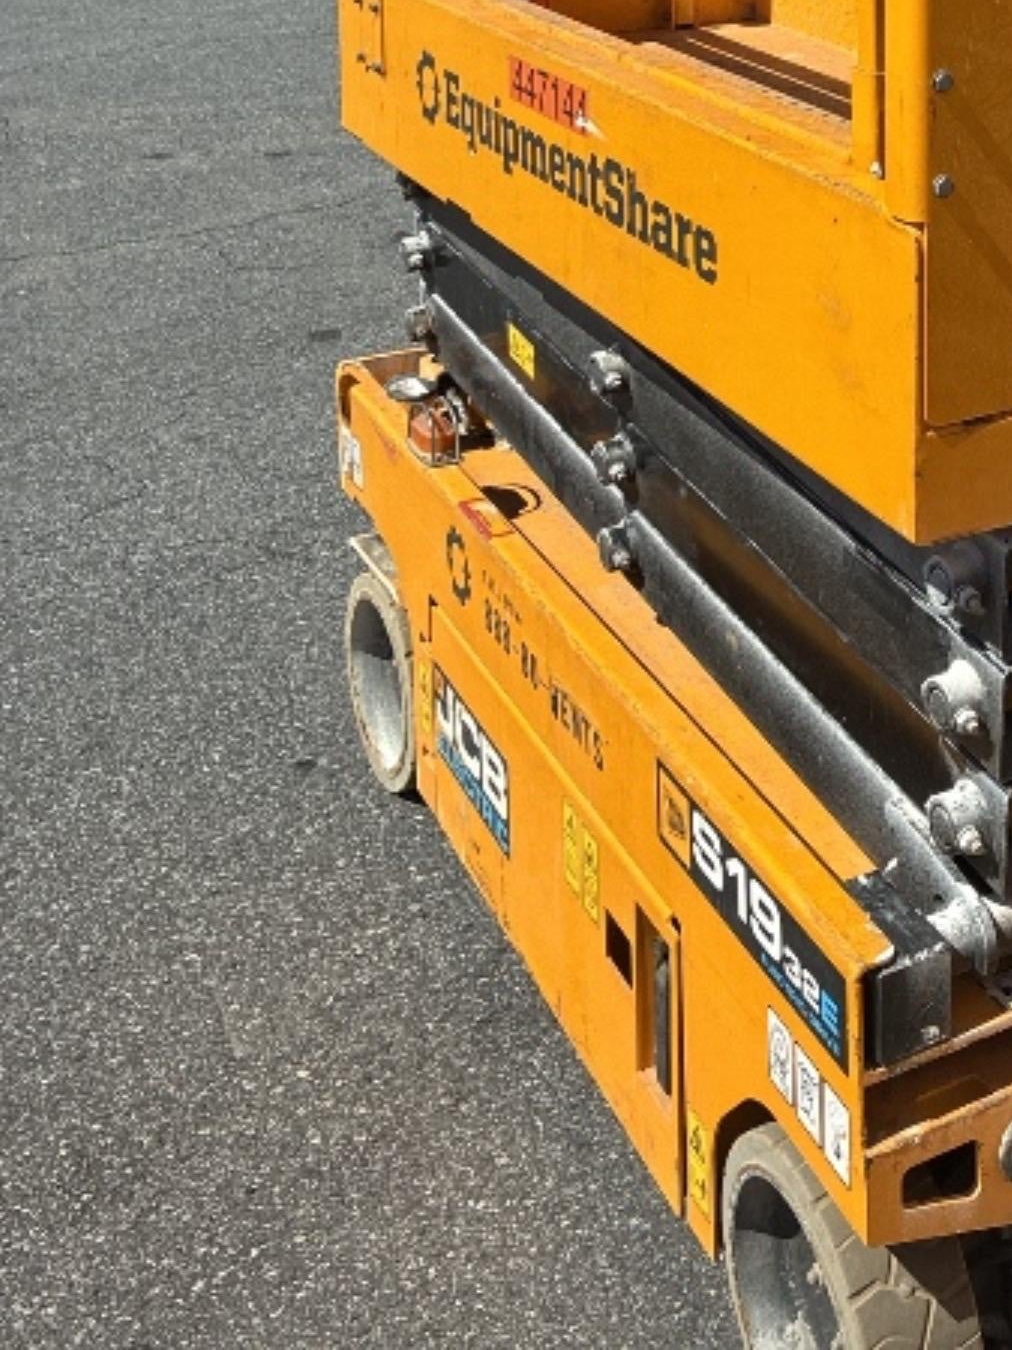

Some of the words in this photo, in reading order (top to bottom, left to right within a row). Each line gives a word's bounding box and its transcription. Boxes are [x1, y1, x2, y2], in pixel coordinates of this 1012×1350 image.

[512, 59, 588, 136] 447144
[443, 68, 719, 285] EquipmentShare
[435, 683, 508, 821] JCB
